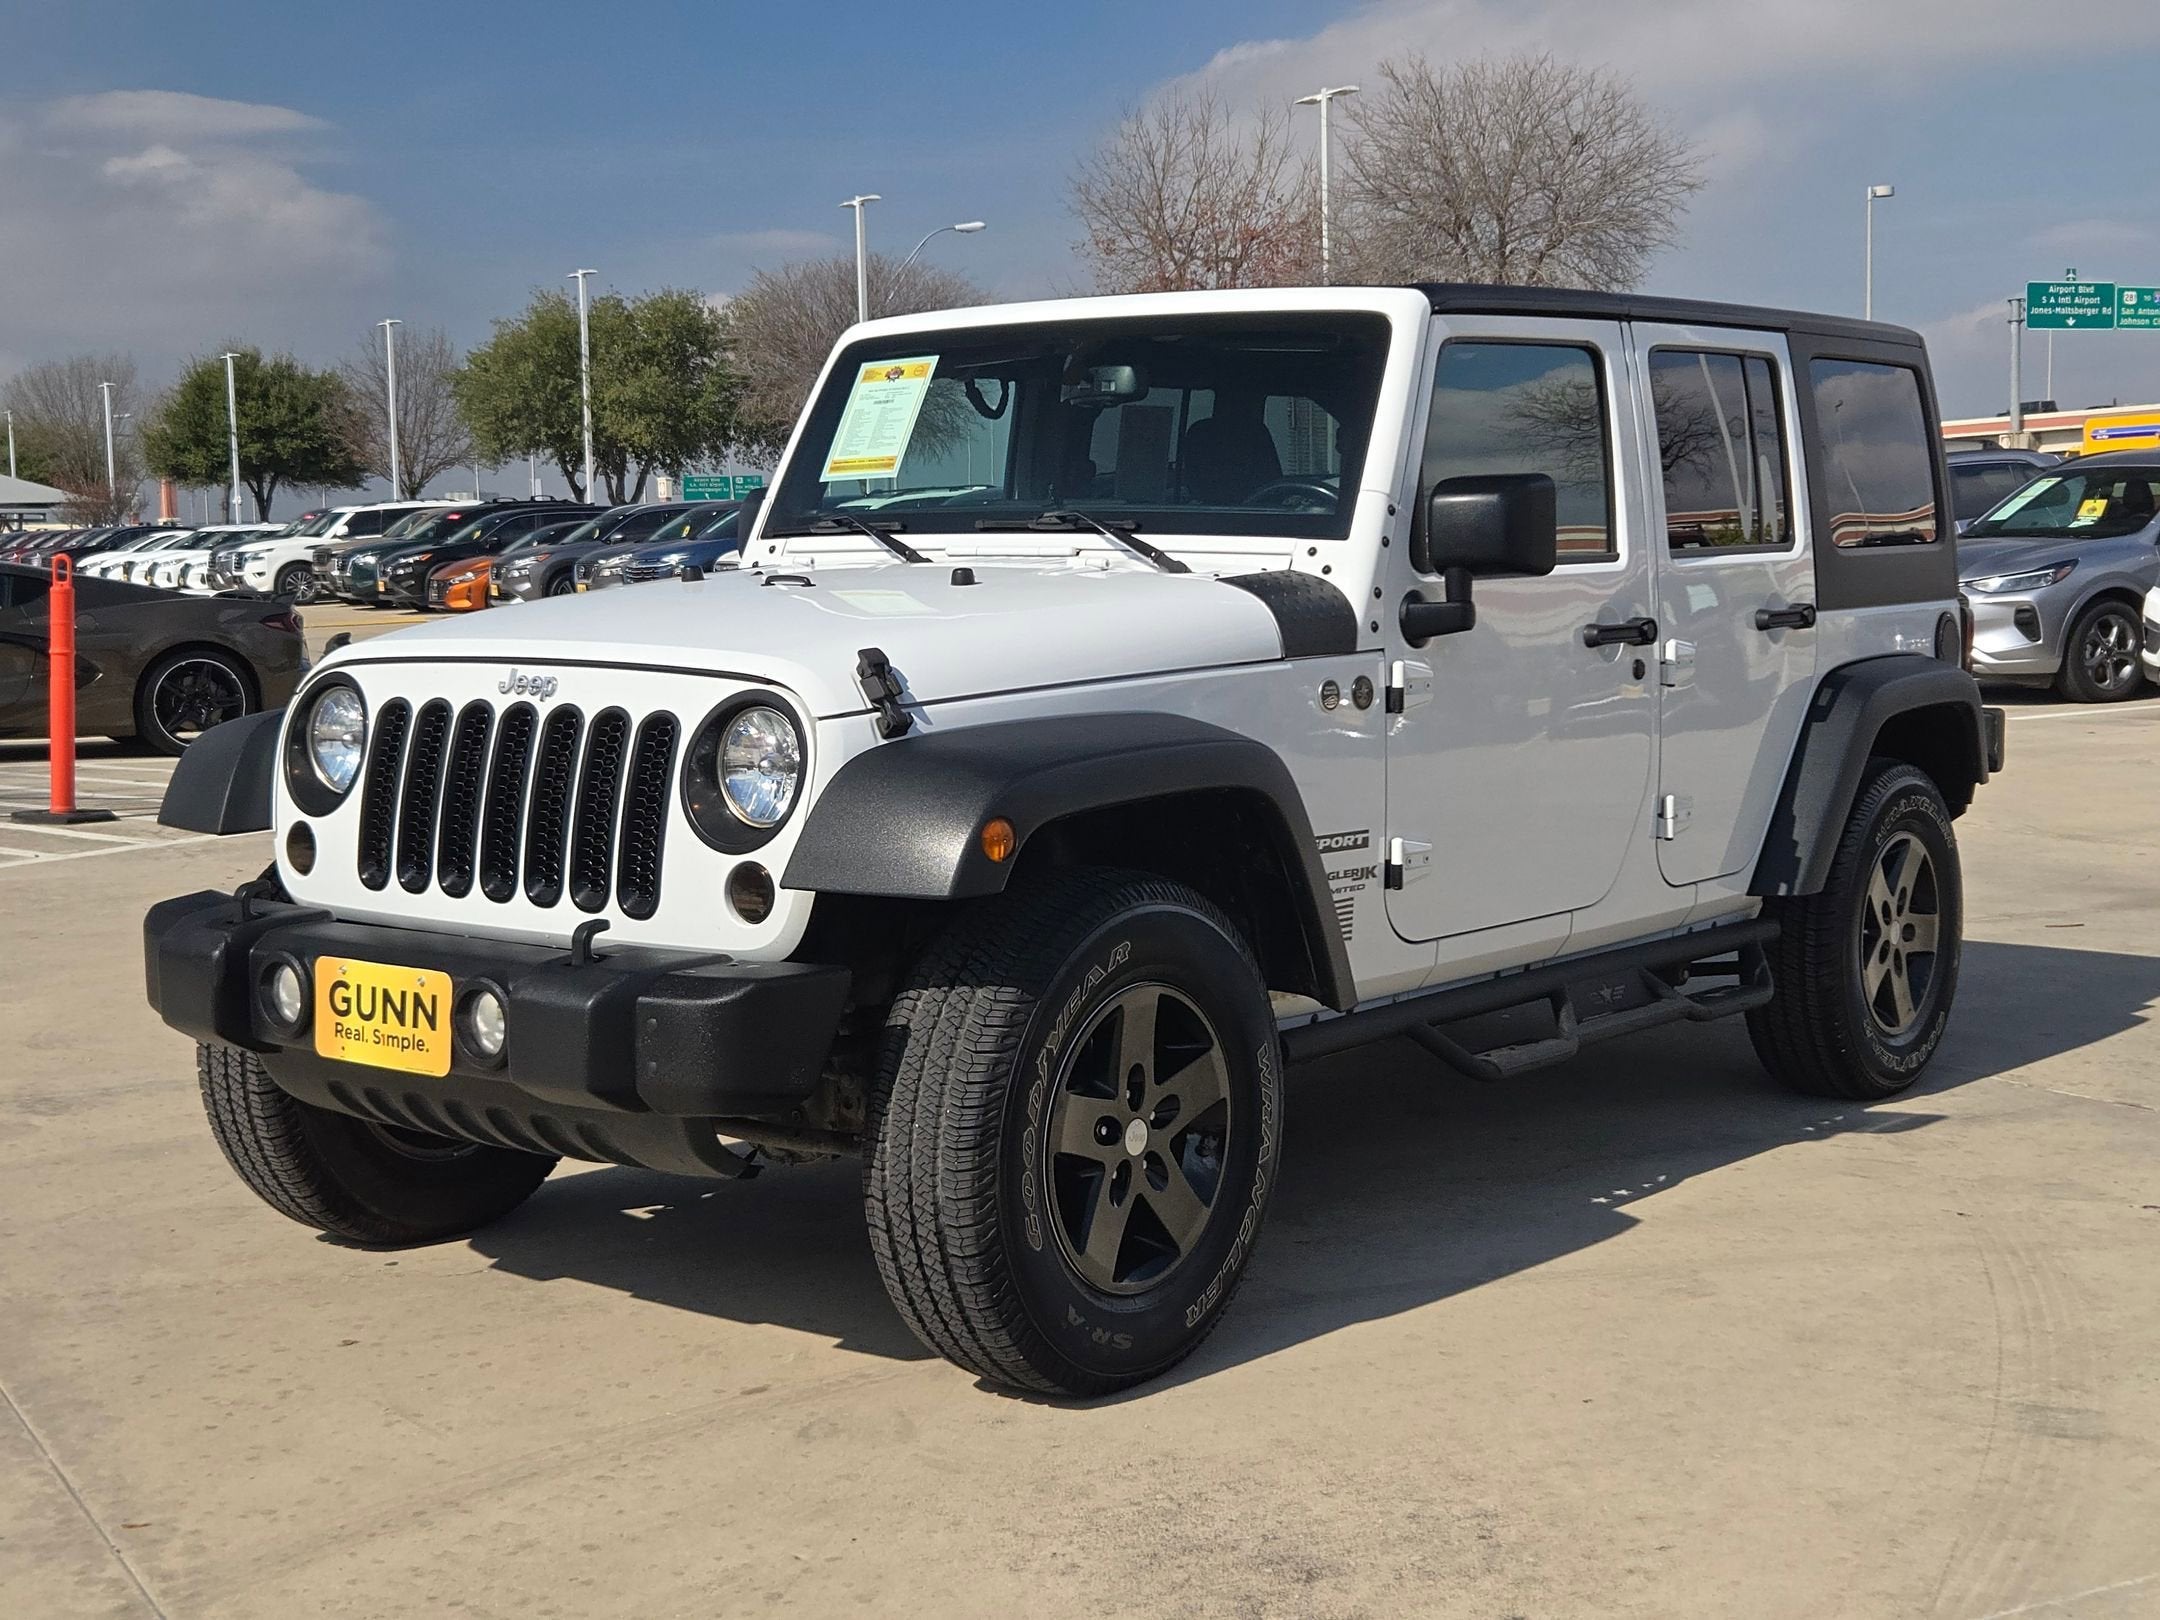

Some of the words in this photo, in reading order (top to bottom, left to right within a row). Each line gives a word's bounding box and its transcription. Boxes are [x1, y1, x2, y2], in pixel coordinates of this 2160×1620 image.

[2048, 285, 2075, 294] Airport
[2078, 285, 2095, 293] Blvd
[2049, 296, 2055, 304] A
[2074, 296, 2101, 305] Airport
[2030, 306, 2099, 317] Jones-Maltsberger
[2102, 306, 2112, 315] Rd
[2119, 317, 2150, 325] Johnson
[498, 668, 559, 702] Jeep
[328, 979, 438, 1032] GUNN
[334, 1021, 369, 1044] Real.
[1022, 941, 1131, 1252] GOODYEAR
[1184, 1040, 1274, 1328] WRANGLER
